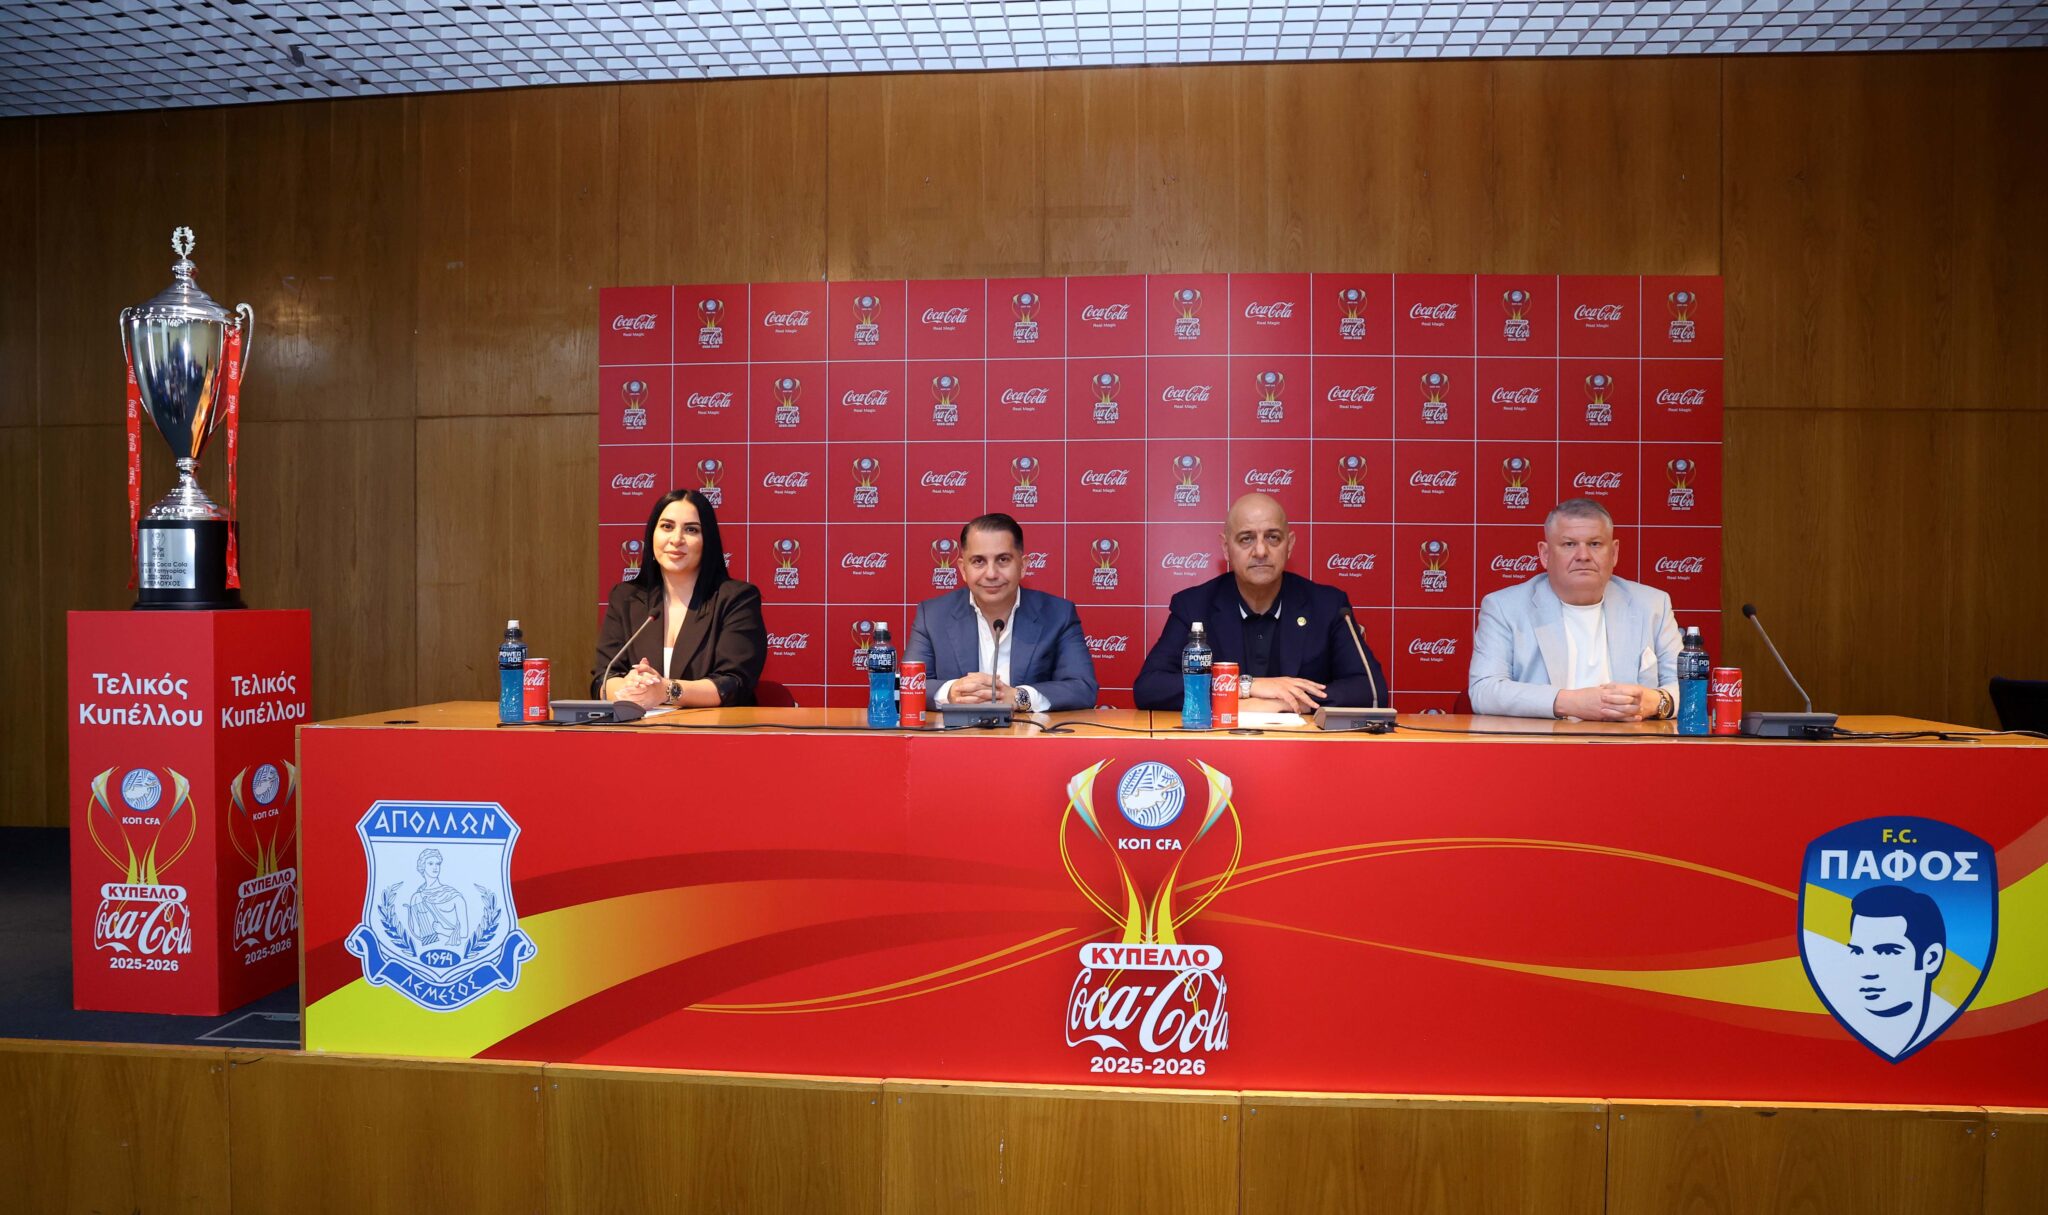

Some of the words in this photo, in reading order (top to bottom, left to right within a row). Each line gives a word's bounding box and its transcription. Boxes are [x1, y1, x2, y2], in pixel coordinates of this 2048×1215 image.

[764, 310, 811, 326] Coca-Cola
[922, 308, 969, 324] Coca-Cola
[1082, 304, 1130, 321] Coca-Cola
[1245, 302, 1294, 318] Coca-Cola
[1410, 303, 1459, 319] Coca-Cola
[1574, 304, 1624, 320] Coca-Cola
[612, 314, 657, 330] Coca-Cola
[687, 392, 733, 408] Coca-Cola
[842, 390, 890, 406] Coca-Cola
[1001, 388, 1049, 404] Coca-Cola
[1162, 385, 1212, 401] Coca-Cola
[1327, 385, 1377, 402] Coca-Cola
[1492, 387, 1541, 403] Coca-Cola
[1656, 389, 1706, 405] Coca-Cola
[612, 473, 656, 489] Coca-Cola
[763, 472, 810, 487] Coca-Cola
[921, 471, 969, 486] Coca-Cola
[1081, 469, 1129, 485] Coca-Cola
[1244, 469, 1294, 485] Coca-Cola
[1410, 470, 1459, 486] Coca-Cola
[1573, 472, 1623, 488] Coca-Cola
[841, 552, 889, 568] Coca-Cola
[1162, 553, 1210, 568] Coca-Cola
[1327, 553, 1376, 570] Coca-Cola
[1491, 555, 1540, 571] Coca-Cola
[1655, 556, 1705, 573] Coca-Cola
[1408, 638, 1458, 654] Coca-Cola
[92, 672, 188, 700] Τελικός
[231, 670, 296, 696] Τελικός
[80, 702, 202, 726] Κυπέλλου
[222, 700, 305, 728] Κυπέλλου
[122, 816, 142, 824] ΚΟΠ
[374, 810, 495, 834] ΑΠΟΛΛΩΝ
[1118, 838, 1151, 850] ΚΟΠ
[1156, 839, 1182, 850] CFA
[1882, 829, 1918, 844] F.C.
[1820, 850, 1979, 882] ΠΑΦΟΣ
[244, 871, 291, 895] ΚΥΠΕΛΛΟ
[108, 886, 178, 899] ΚΥΠΕΛΛΟ
[245, 938, 292, 965] 2025-2026
[425, 952, 454, 966] 1954
[1092, 948, 1210, 966] ΚΥΠΕΛΛΟ
[110, 958, 178, 971] 2025-2026
[400, 974, 481, 1004] ΛΕΜΕΣΟΣ
[1066, 968, 1229, 1053] Coca-Cola
[1090, 1056, 1206, 1075] 2025-2026
